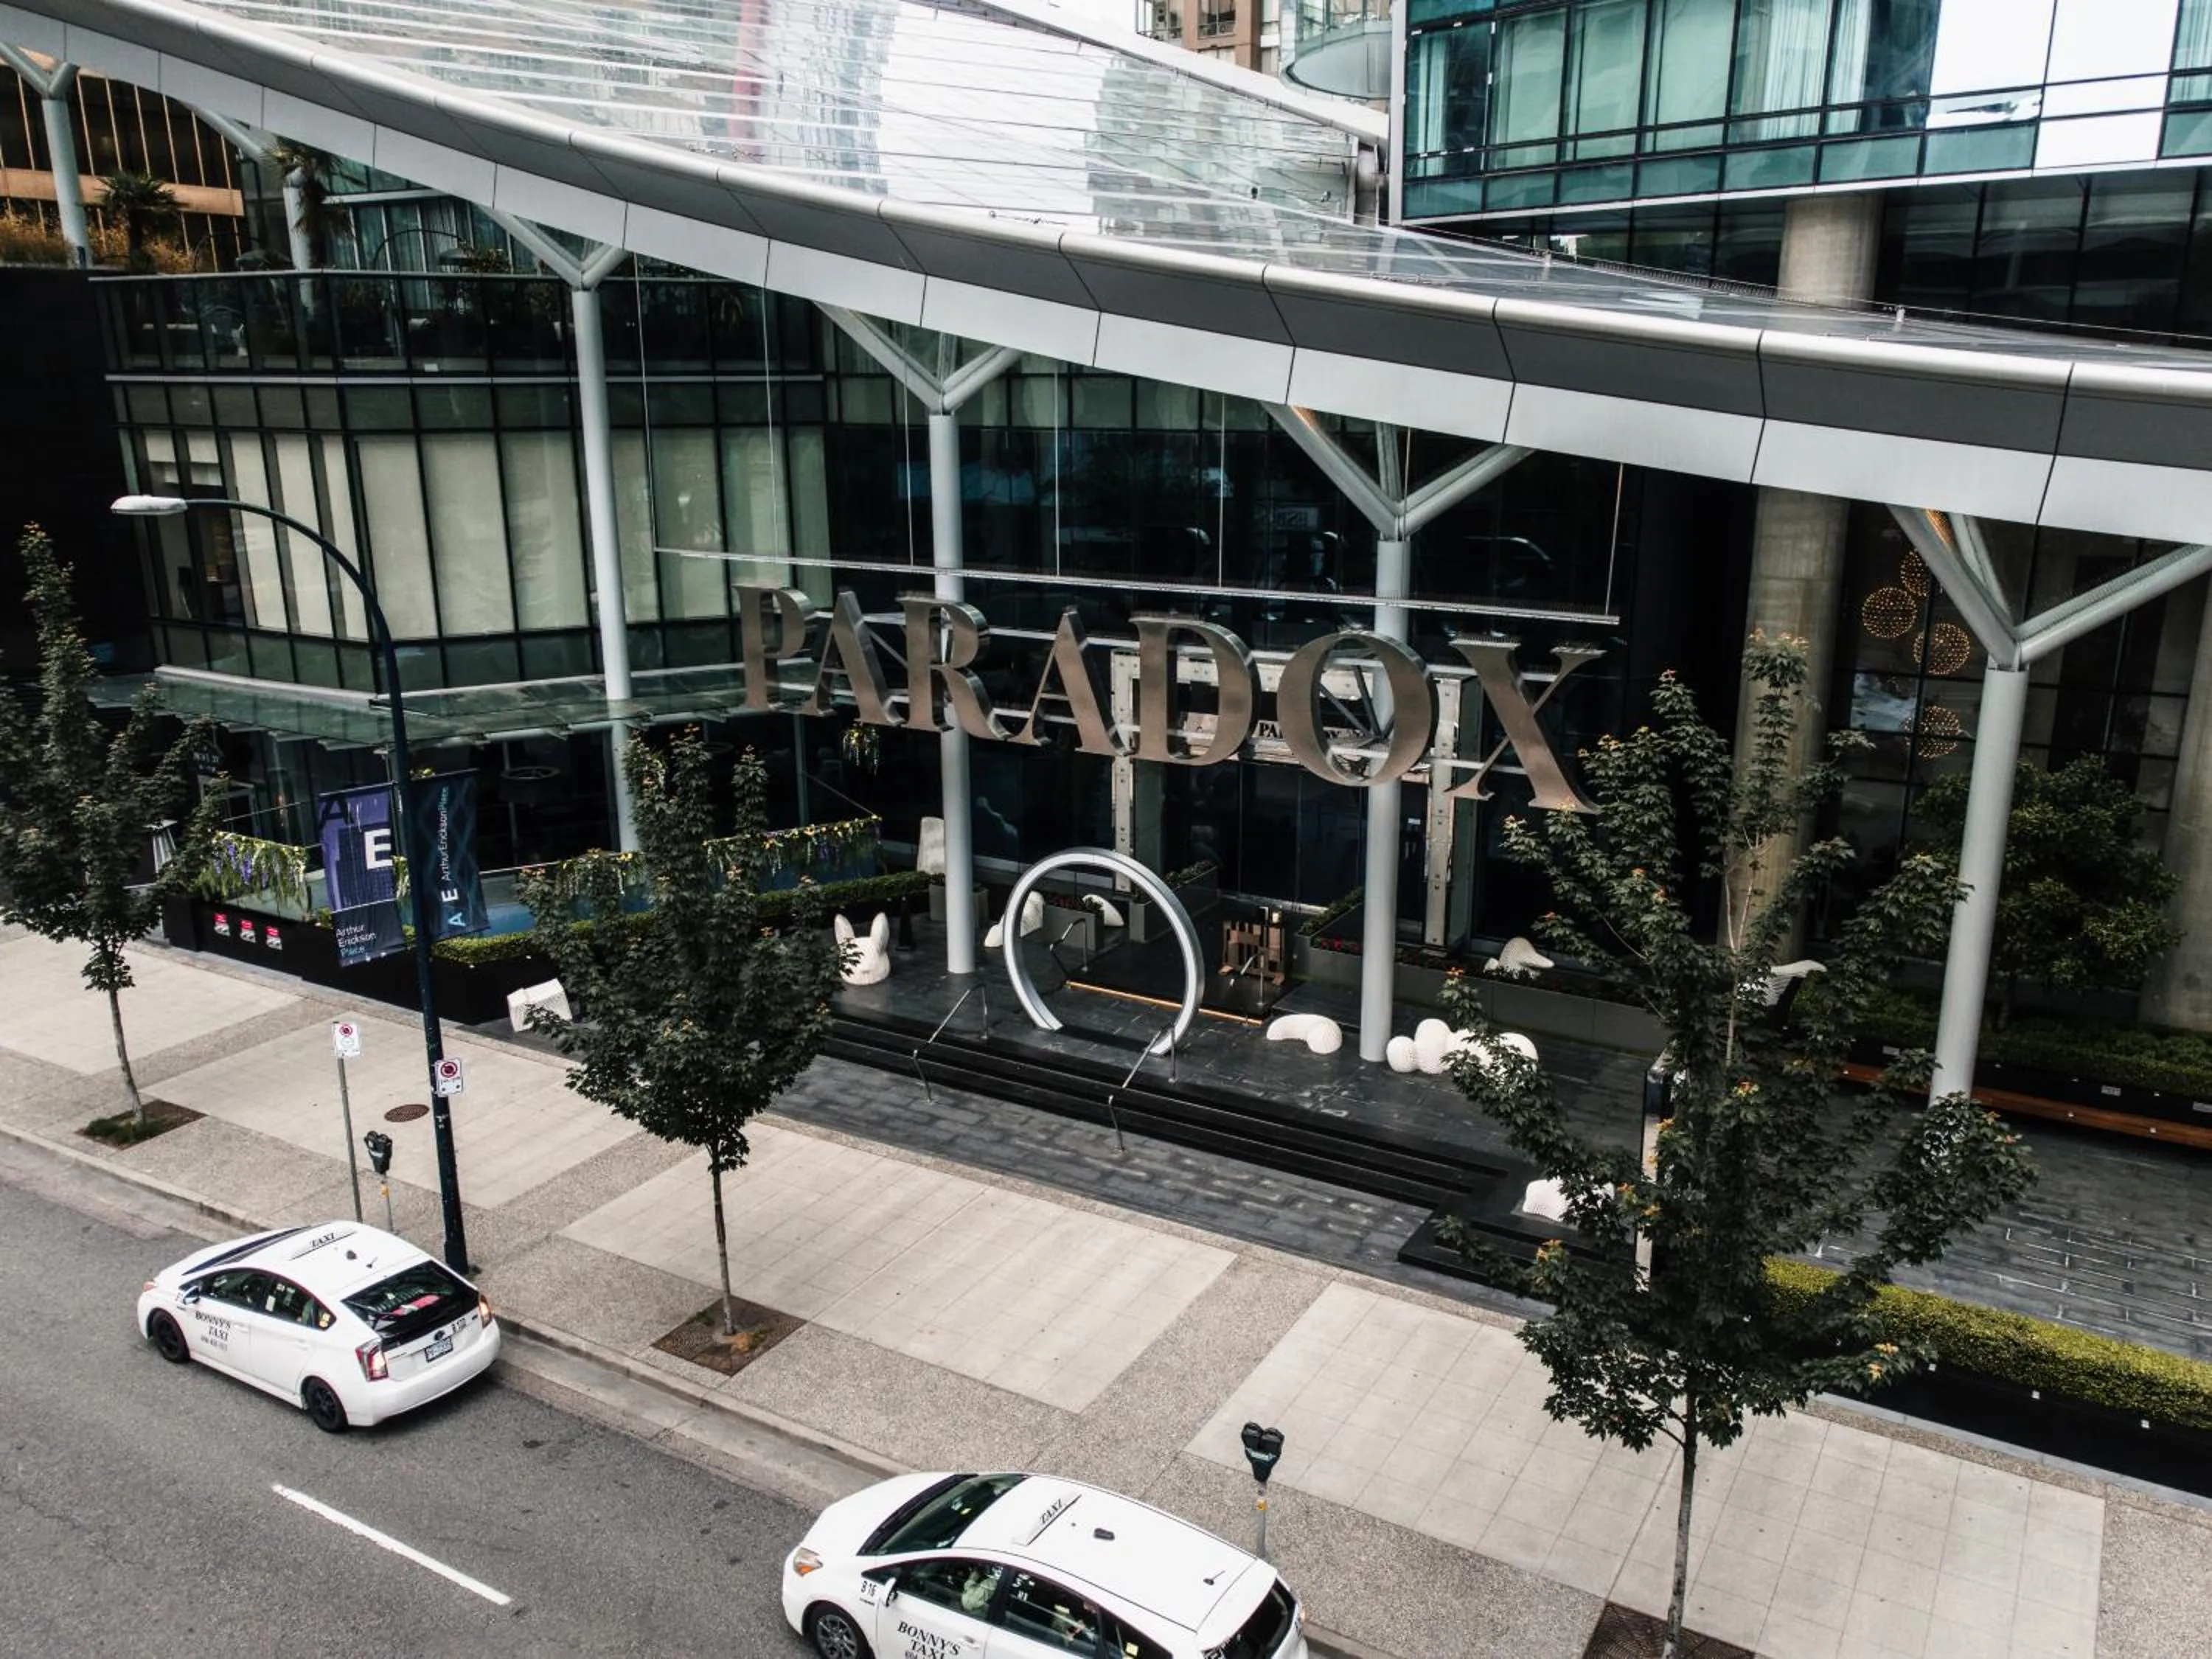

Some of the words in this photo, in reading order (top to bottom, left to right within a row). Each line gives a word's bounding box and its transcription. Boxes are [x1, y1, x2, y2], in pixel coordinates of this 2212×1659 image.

[734, 587, 1607, 815] PARADOX
[364, 828, 393, 870] E
[441, 888, 459, 902] E
[448, 911, 466, 927] A
[335, 925, 365, 938] Arthur
[338, 933, 377, 947] Erickson
[309, 1232, 334, 1247] TAXI
[209, 1326, 228, 1341] TAXI
[1039, 1498, 1062, 1525] TAXI
[897, 1621, 961, 1656] BONNY'S
[911, 1638, 945, 1659] TAXI
